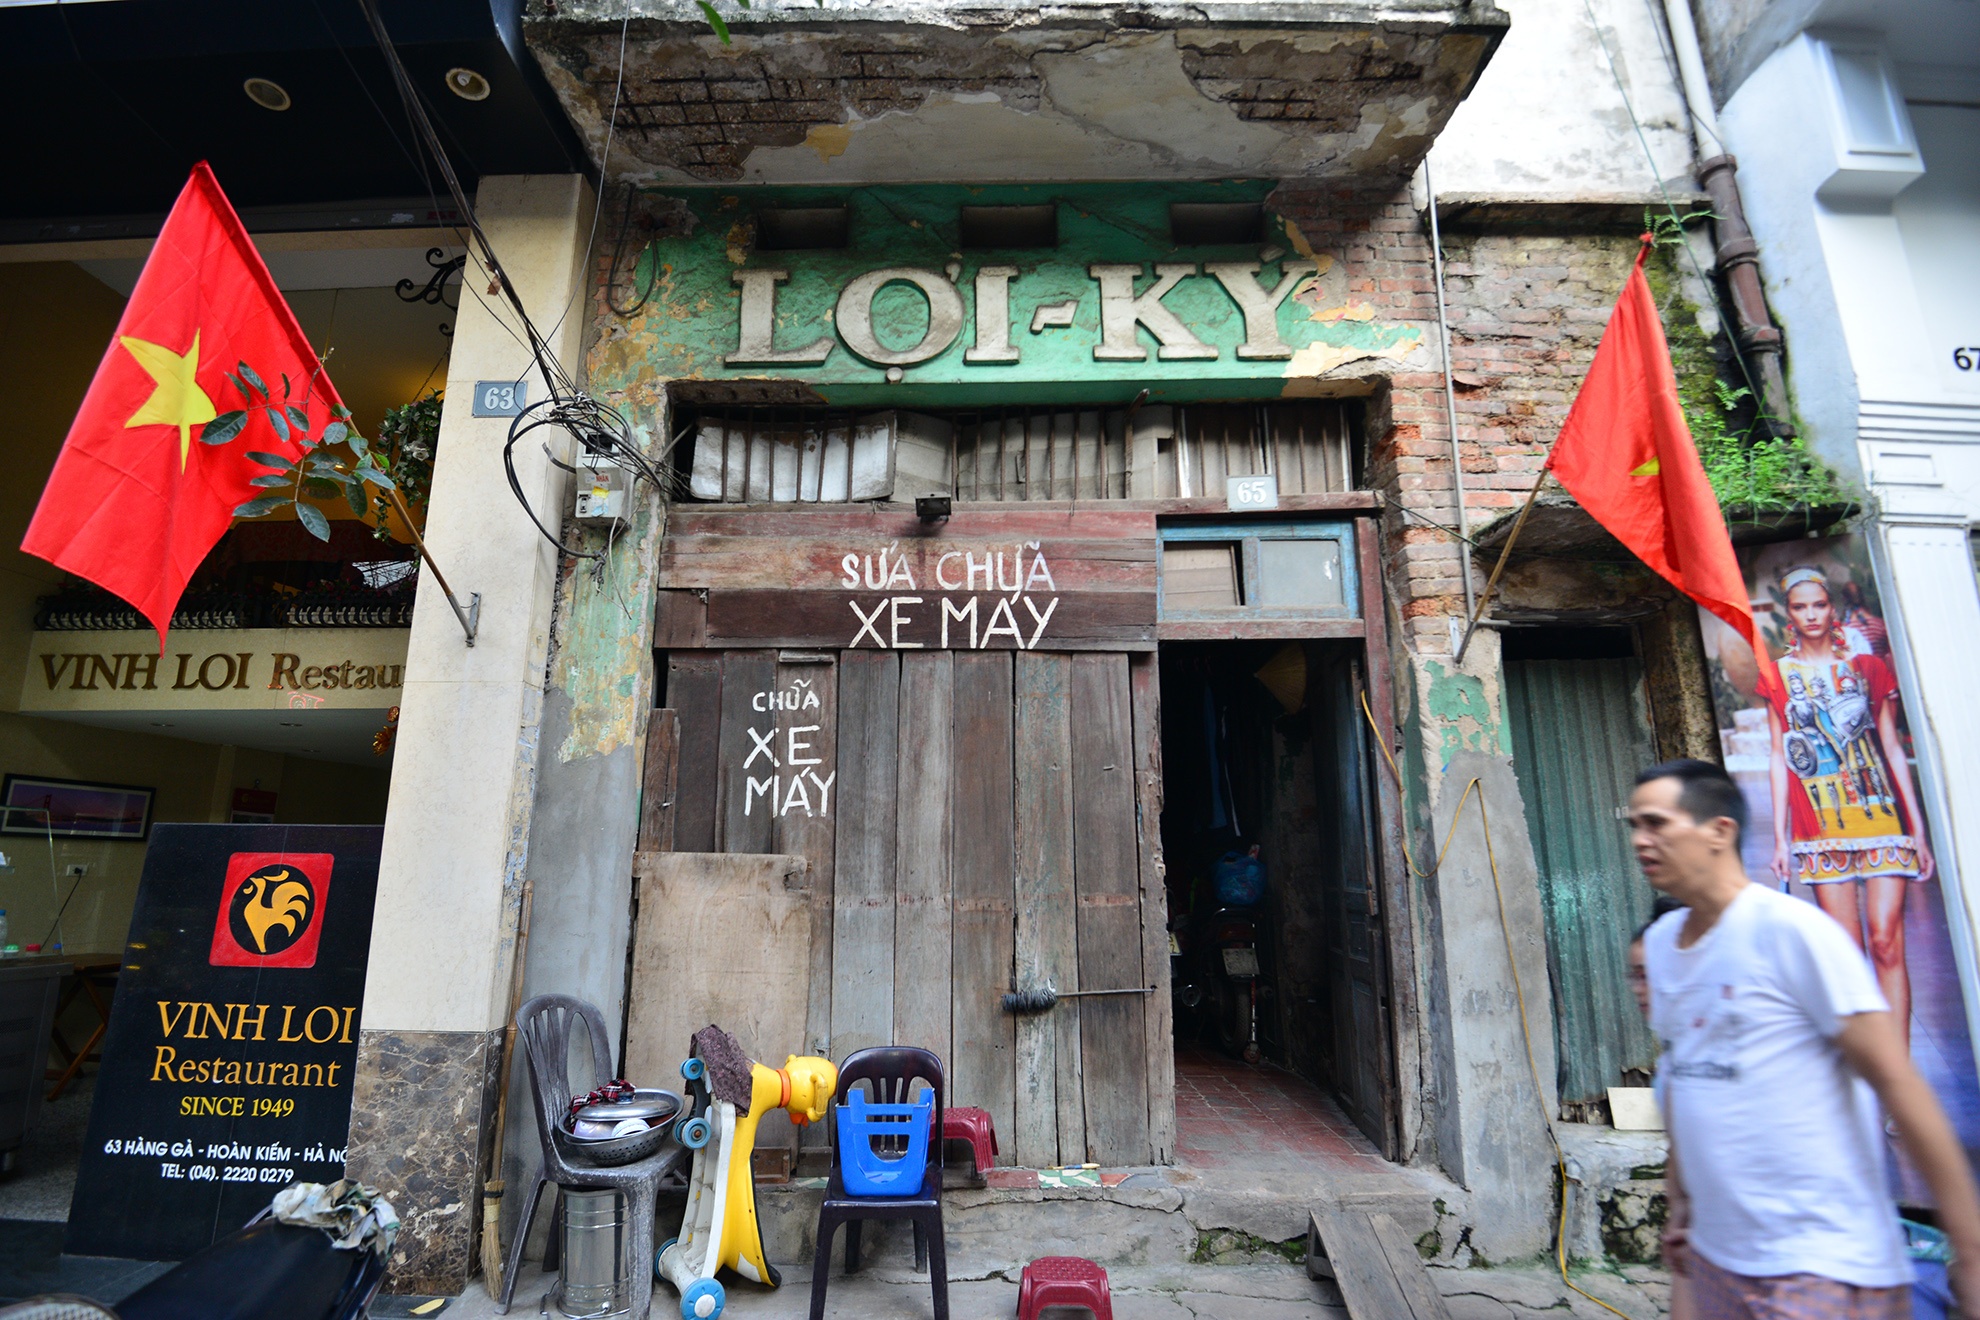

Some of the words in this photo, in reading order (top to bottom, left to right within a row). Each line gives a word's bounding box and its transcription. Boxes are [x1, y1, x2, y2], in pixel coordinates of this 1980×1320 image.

[1953, 347, 1980, 371] 67
[484, 387, 515, 410] 63
[1237, 481, 1267, 504] 65
[848, 596, 924, 649] XE
[941, 590, 1059, 649] MÁY
[39, 652, 160, 690] VINH
[171, 652, 254, 691] LOI
[266, 653, 405, 690] Restau
[743, 725, 823, 769] XE
[743, 766, 836, 818] MÁY
[157, 1001, 271, 1041] VINH
[277, 1004, 356, 1044] LOI
[150, 1045, 342, 1087] Restaurant
[180, 1095, 245, 1117] SINCE
[251, 1098, 295, 1119] 1949
[104, 1139, 122, 1155] 63
[124, 1136, 169, 1157] HÀNG
[170, 1138, 194, 1158] GÀ
[206, 1141, 252, 1161] HOÀN
[255, 1140, 292, 1162] KIẾM
[303, 1141, 325, 1162] HÀ
[161, 1162, 186, 1179] TEL:
[188, 1164, 220, 1182] (04).
[223, 1166, 257, 1182] 2220
[259, 1168, 295, 1184] 0279
